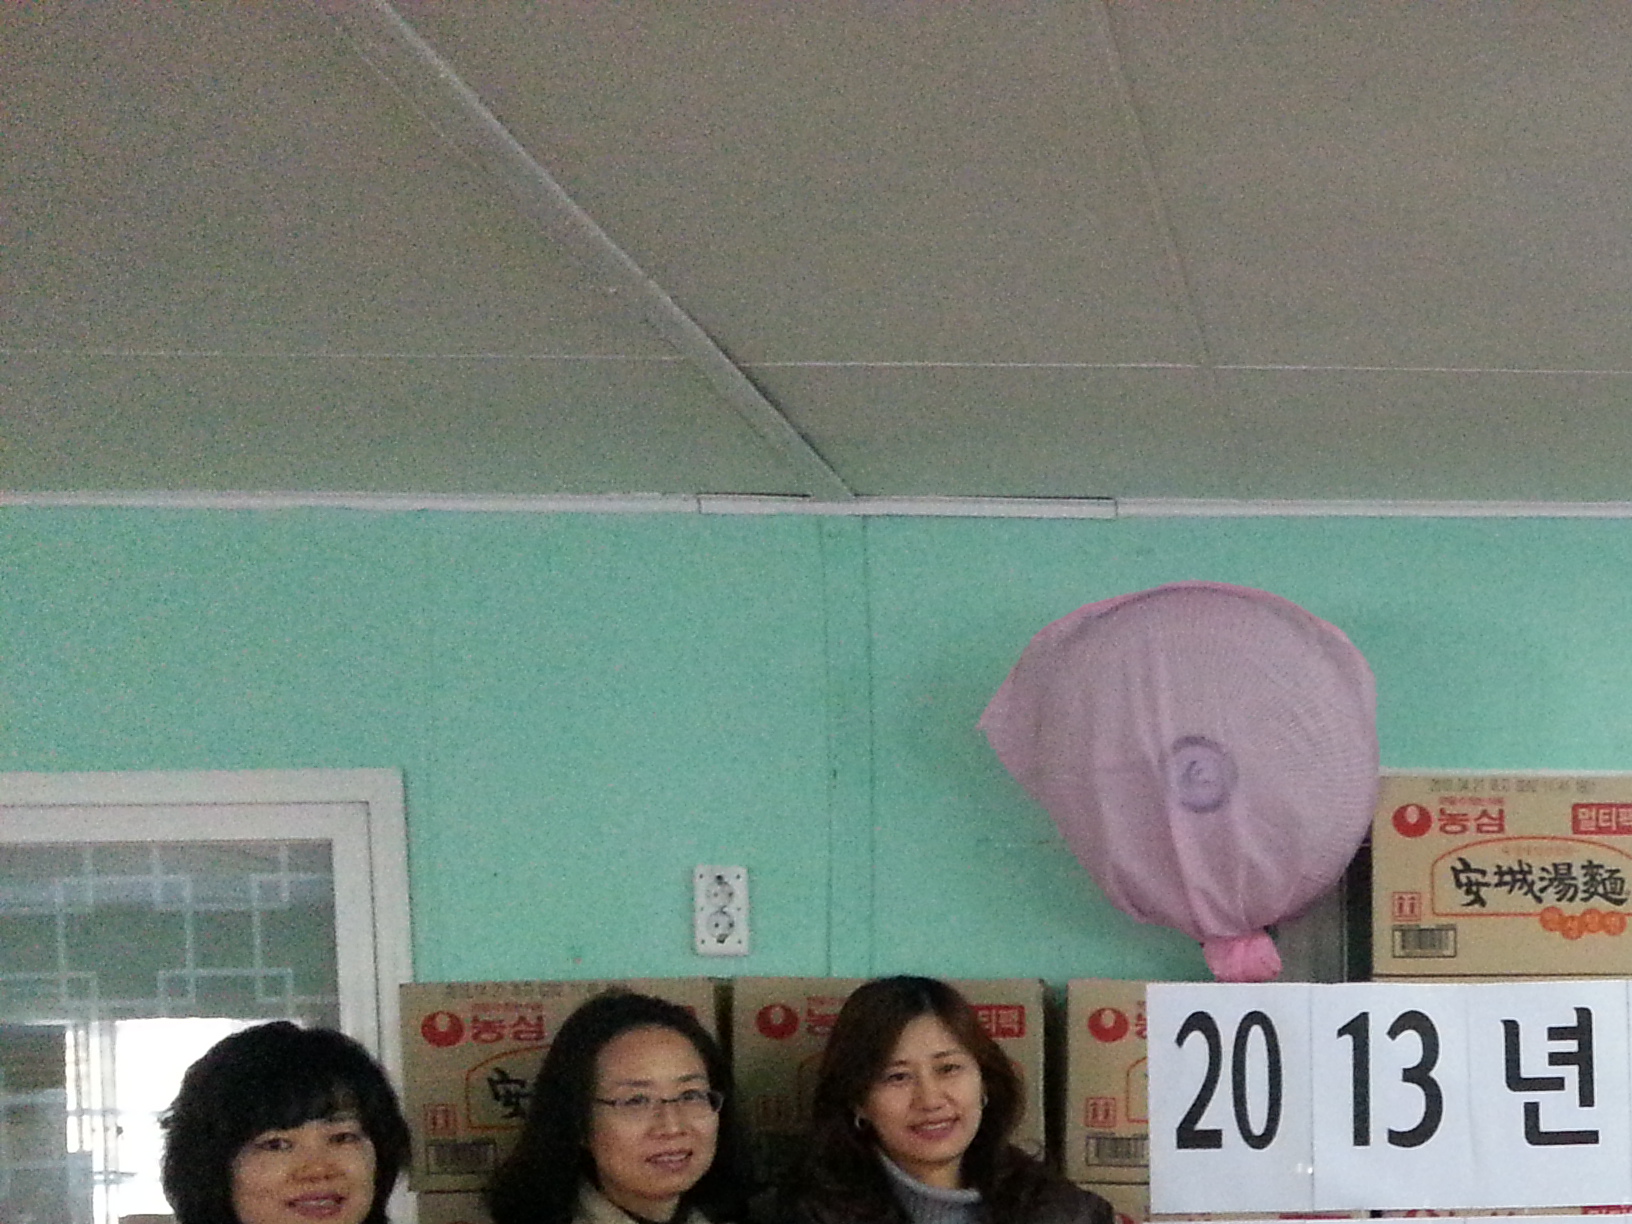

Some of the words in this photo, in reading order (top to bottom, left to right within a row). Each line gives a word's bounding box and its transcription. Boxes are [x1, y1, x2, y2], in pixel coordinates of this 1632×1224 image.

[1438, 807, 1505, 834] 농심
[1451, 857, 1630, 907] 安城湯麵
[471, 1015, 545, 1043] 농심
[976, 1009, 1020, 1033] 티팩
